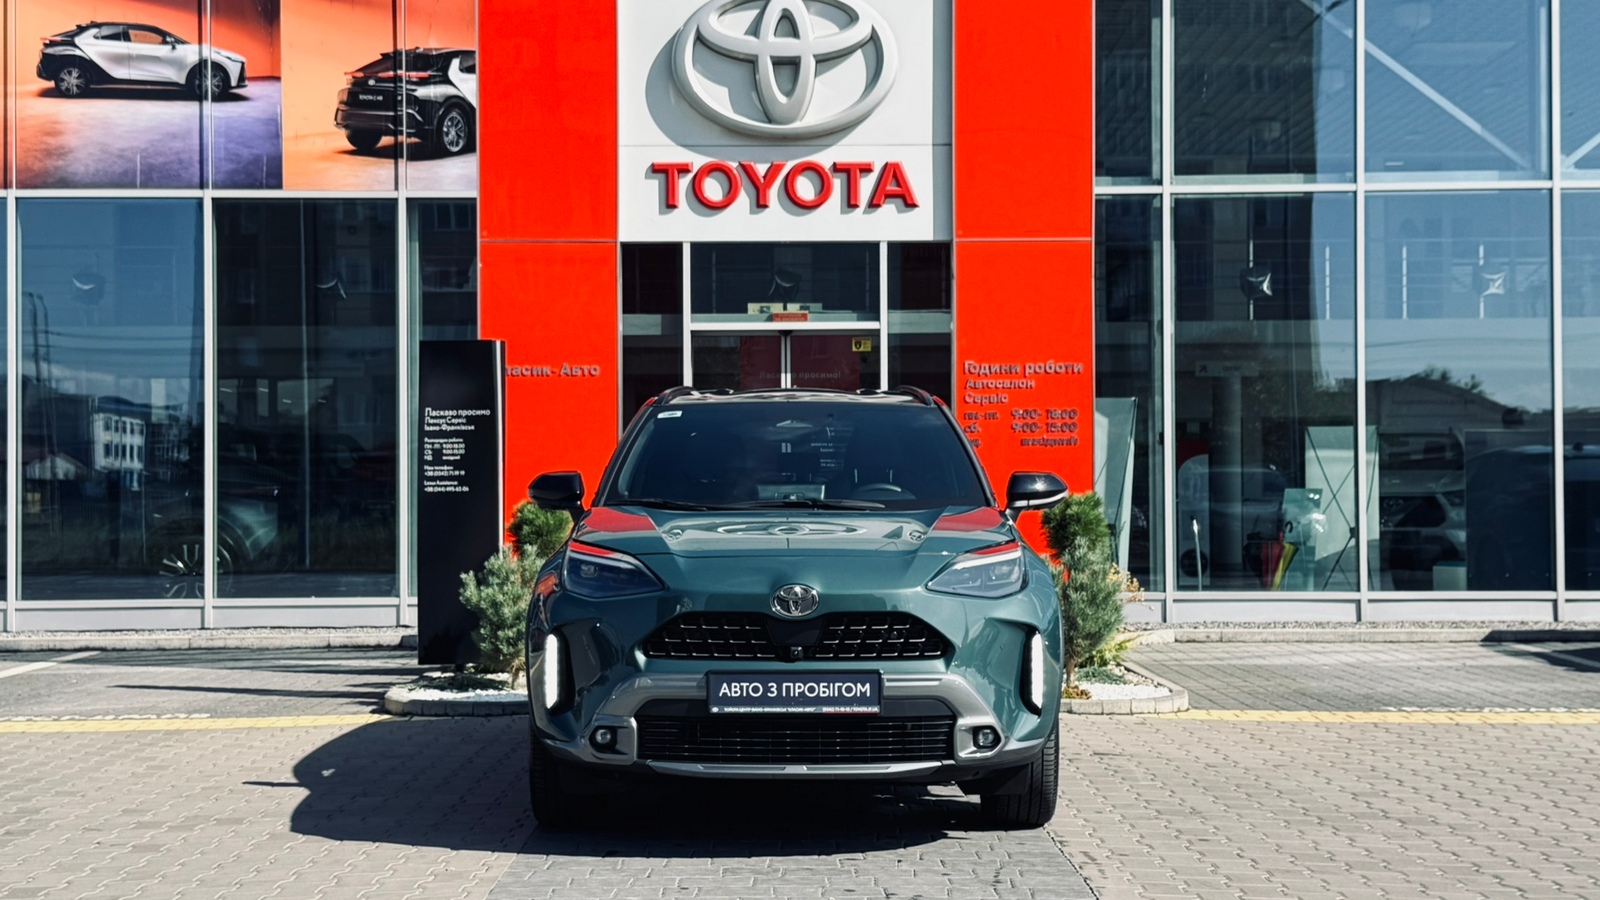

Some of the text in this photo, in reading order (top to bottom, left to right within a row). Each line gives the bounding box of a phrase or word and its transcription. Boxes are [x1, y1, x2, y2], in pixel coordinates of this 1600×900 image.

[651, 160, 920, 209] TOYOTA
[963, 359, 1083, 377] Години роботи
[964, 379, 1035, 390] Автосалон
[963, 392, 1008, 406] Сервіс
[425, 407, 491, 417] Ласкаво просимо
[719, 682, 871, 698] АВТО З ПРОБІГОМ
